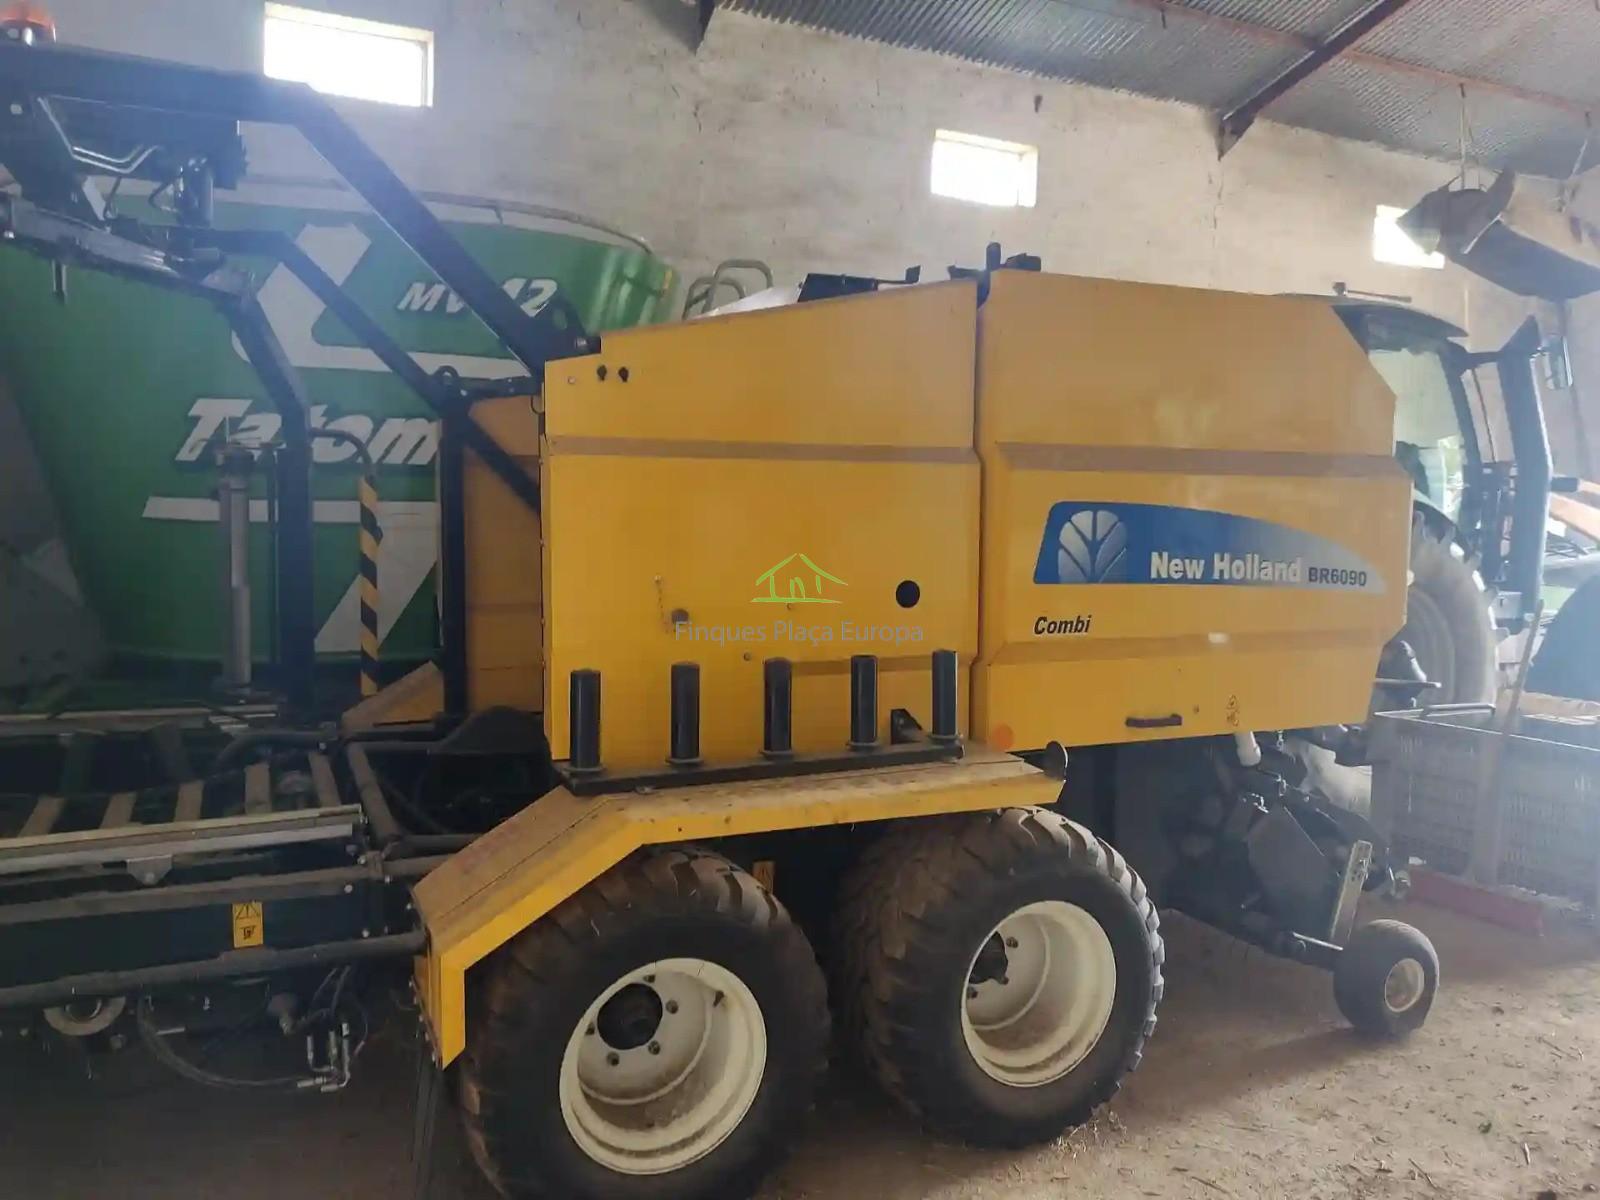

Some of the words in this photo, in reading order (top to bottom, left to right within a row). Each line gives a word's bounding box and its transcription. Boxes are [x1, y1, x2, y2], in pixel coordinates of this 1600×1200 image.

[1150, 551, 1205, 579] New
[1213, 552, 1302, 582] Holland
[1308, 567, 1368, 587] BR6090
[1034, 614, 1092, 634] Combi
